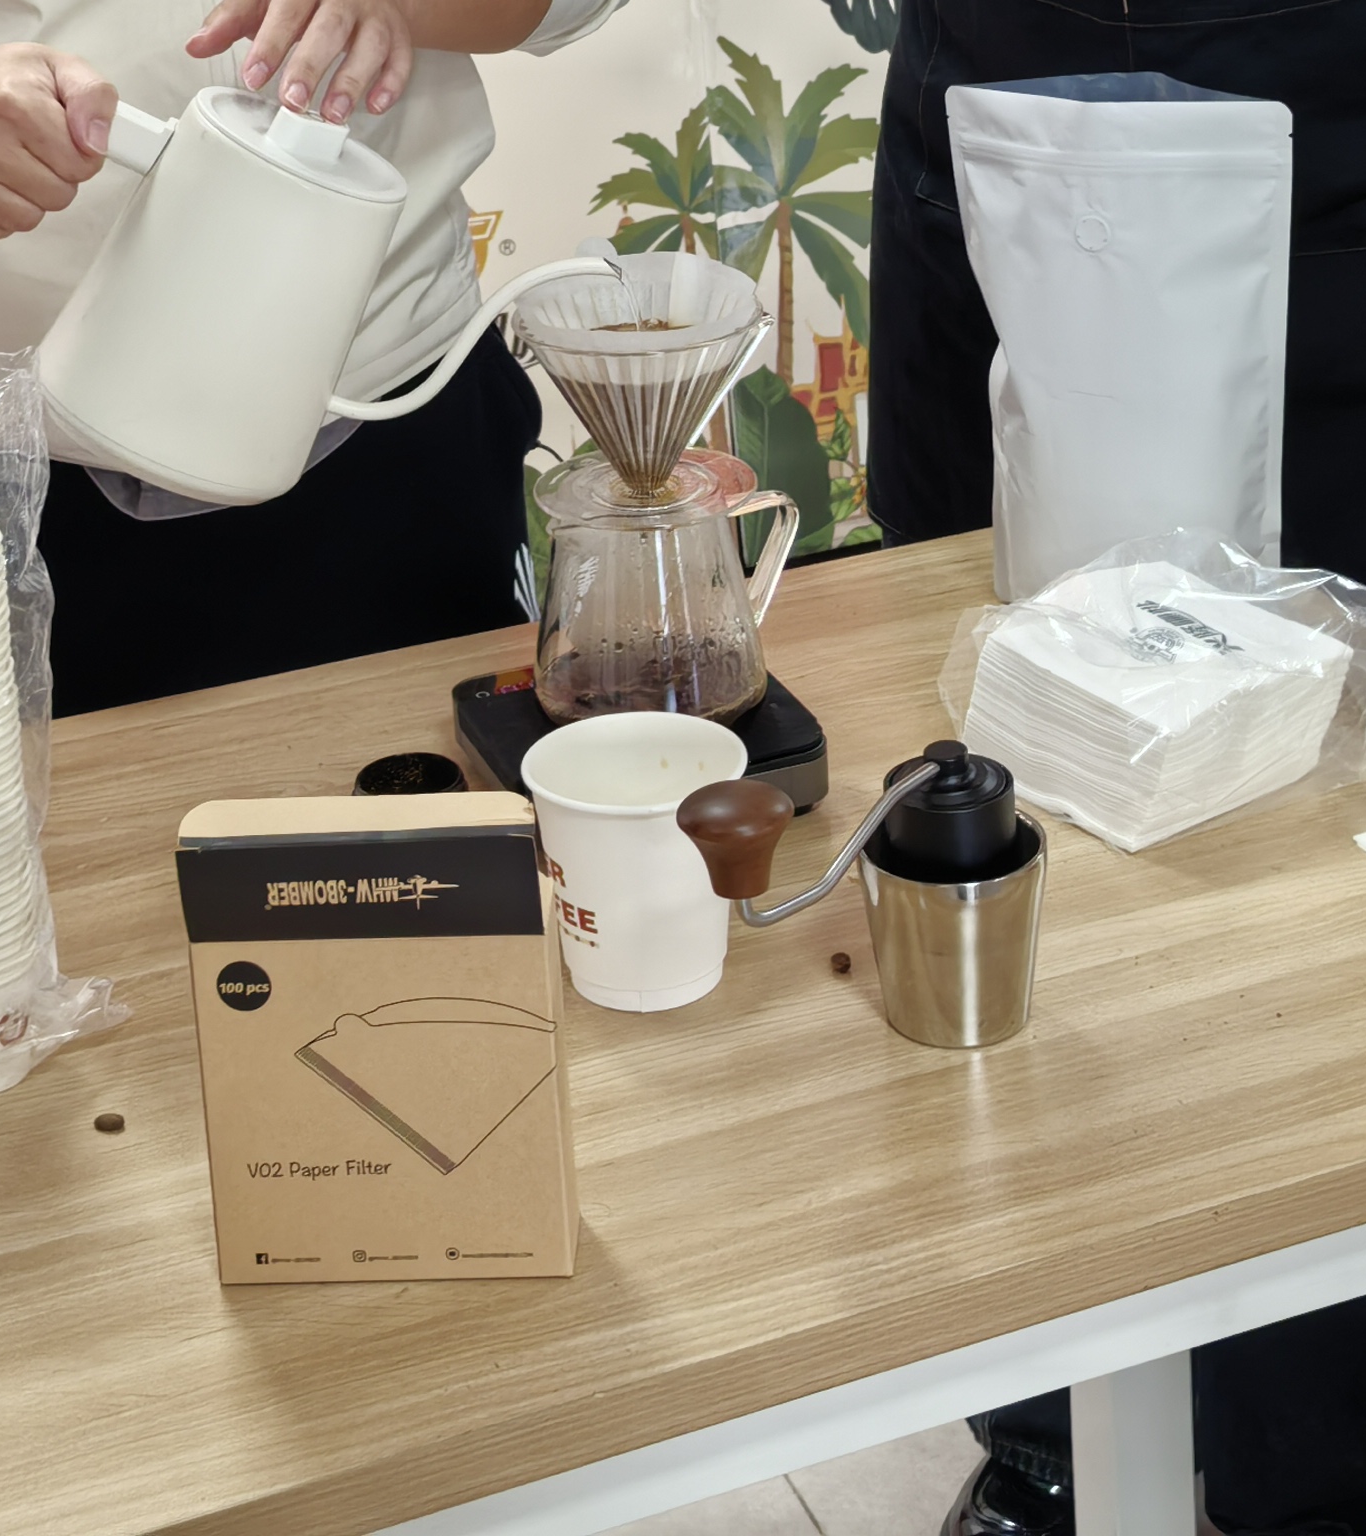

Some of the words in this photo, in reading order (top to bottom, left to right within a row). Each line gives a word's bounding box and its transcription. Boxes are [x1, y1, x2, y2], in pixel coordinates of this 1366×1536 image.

[266, 877, 399, 907] MHW-3BOMBER
[219, 982, 244, 995] 100
[246, 983, 270, 996] pcs
[290, 1161, 339, 1182] Paper
[345, 1159, 392, 1177] Filter
